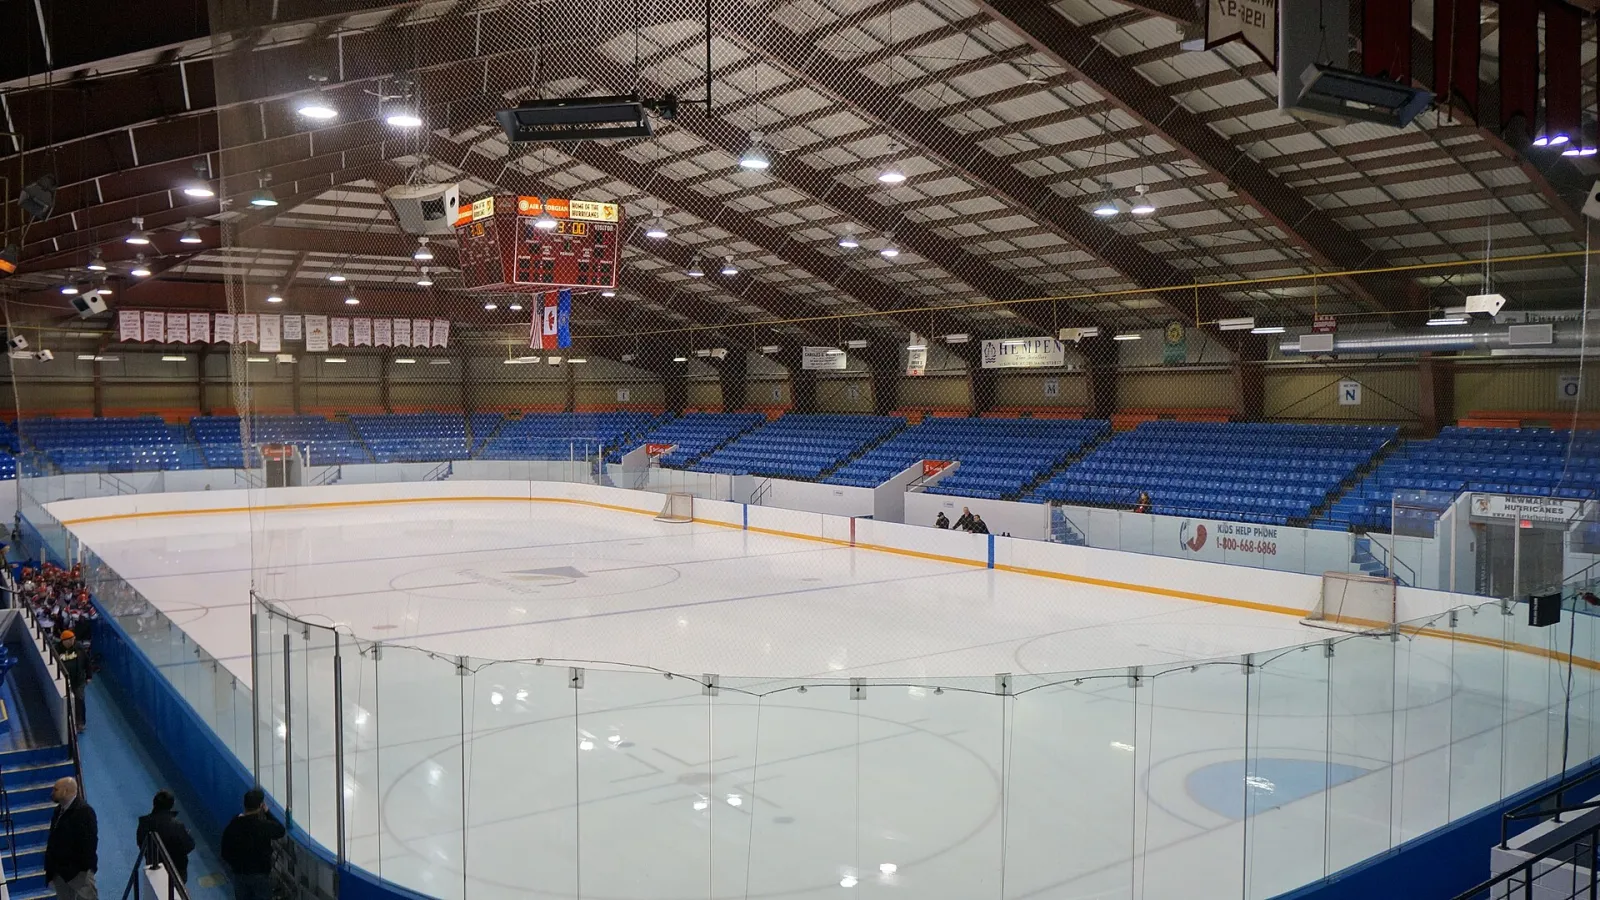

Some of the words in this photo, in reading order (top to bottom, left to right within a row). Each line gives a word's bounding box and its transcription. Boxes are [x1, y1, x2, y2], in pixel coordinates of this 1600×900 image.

[999, 339, 1062, 355] HEMPEN
[1346, 389, 1355, 400] N
[1564, 382, 1578, 396] O
[1504, 504, 1564, 515] HURRICANES
[1217, 524, 1233, 534] KIDS
[1235, 526, 1252, 536] HELP
[1253, 528, 1277, 538] PHONE
[1216, 536, 1277, 555] 1-800-668-6868
